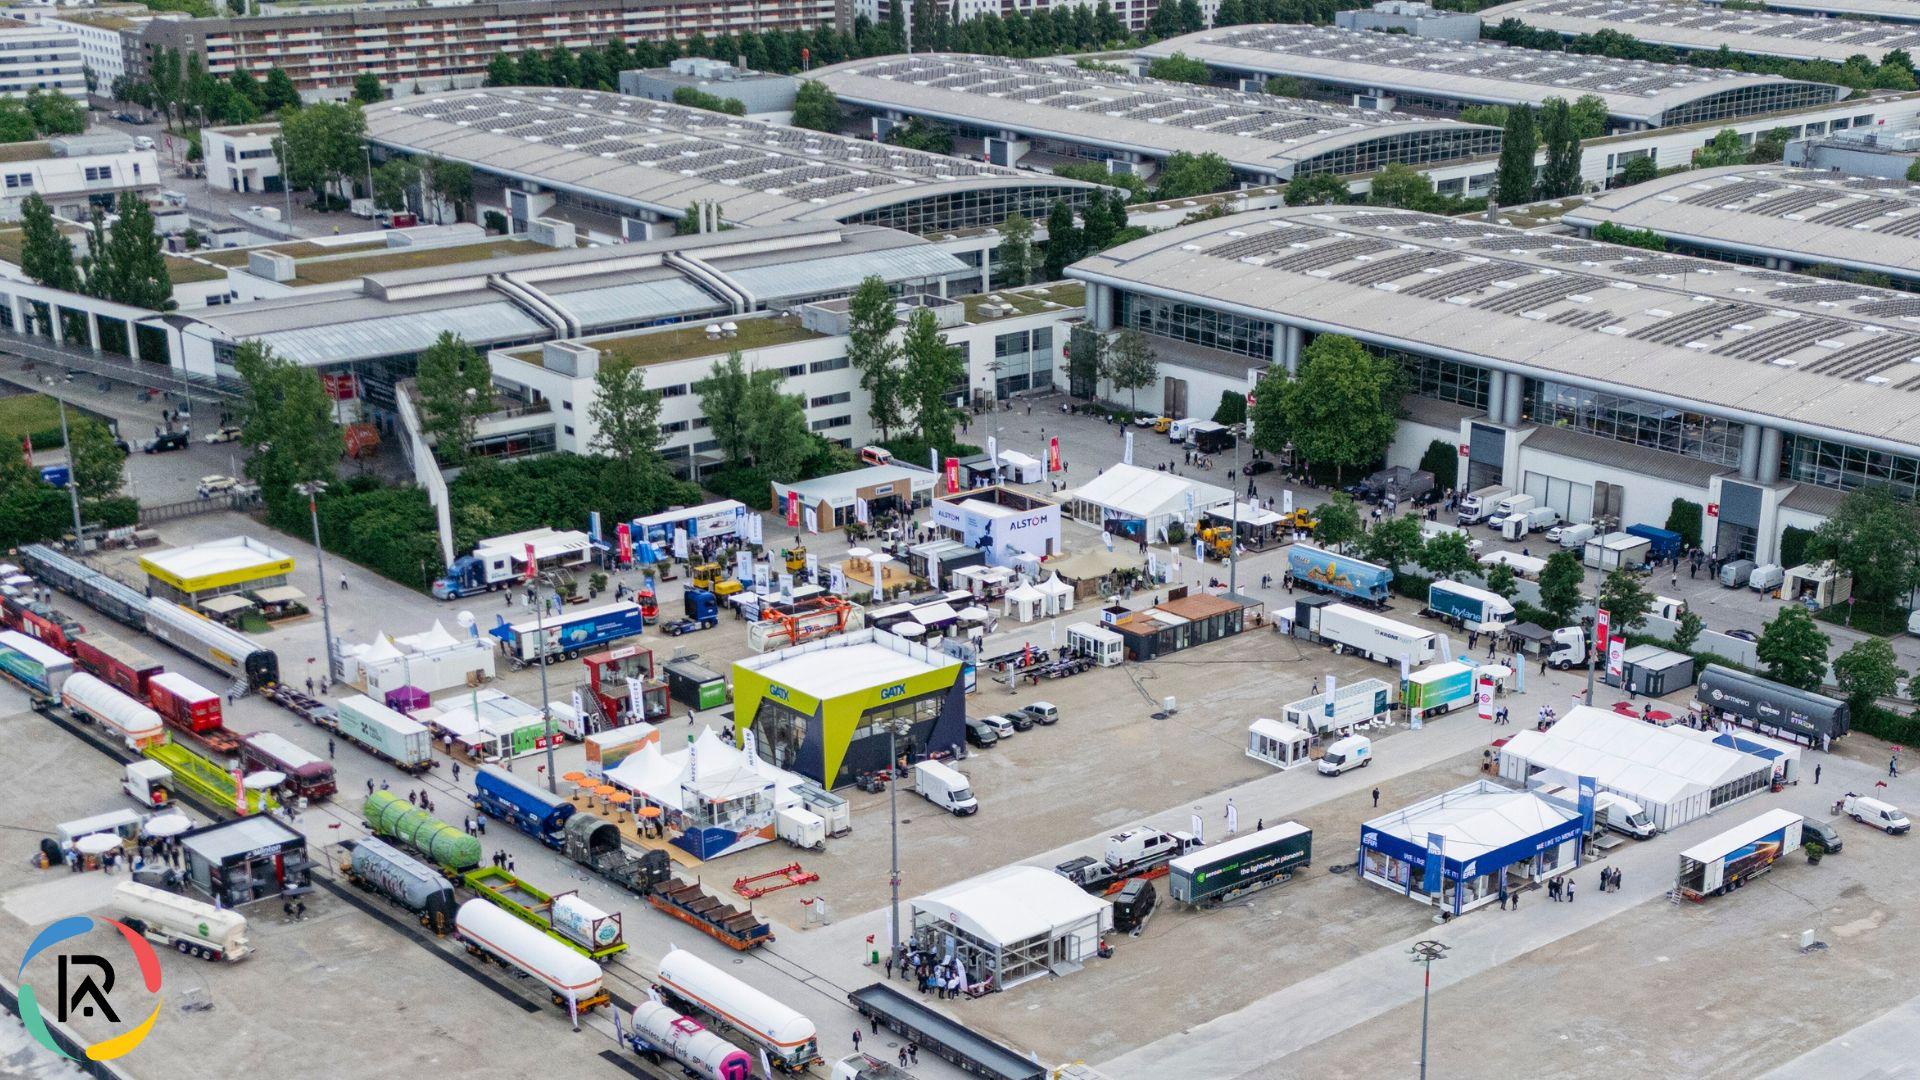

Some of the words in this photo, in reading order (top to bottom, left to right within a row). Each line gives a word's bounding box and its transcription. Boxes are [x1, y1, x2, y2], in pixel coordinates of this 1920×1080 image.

[938, 510, 960, 522] ALSTOM
[1010, 515, 1048, 531] ALSTOM
[1451, 605, 1482, 621] hylane
[1380, 631, 1399, 640] KRONE
[769, 684, 789, 702] GATX
[880, 683, 906, 700] GATX
[1724, 694, 1750, 707] ermewa
[1240, 867, 1250, 876] the
[1250, 857, 1281, 872] lightweight
